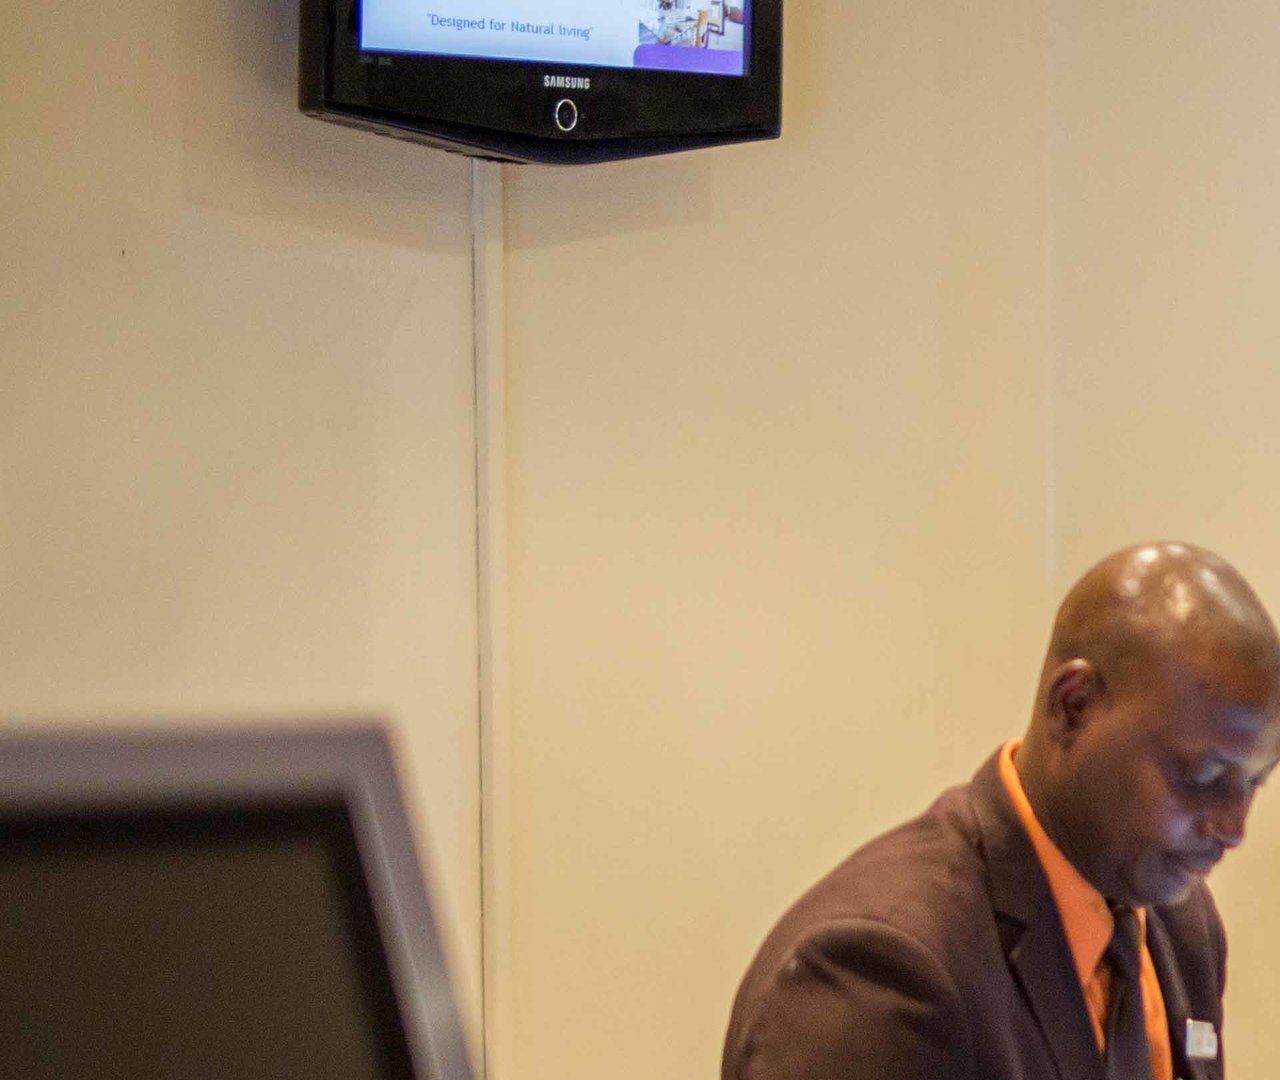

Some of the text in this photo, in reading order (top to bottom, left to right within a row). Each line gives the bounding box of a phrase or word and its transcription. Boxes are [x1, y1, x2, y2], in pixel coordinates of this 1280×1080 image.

[489, 18, 506, 31] for
[511, 21, 554, 35] Natural
[544, 75, 591, 90] SAMSUNG
